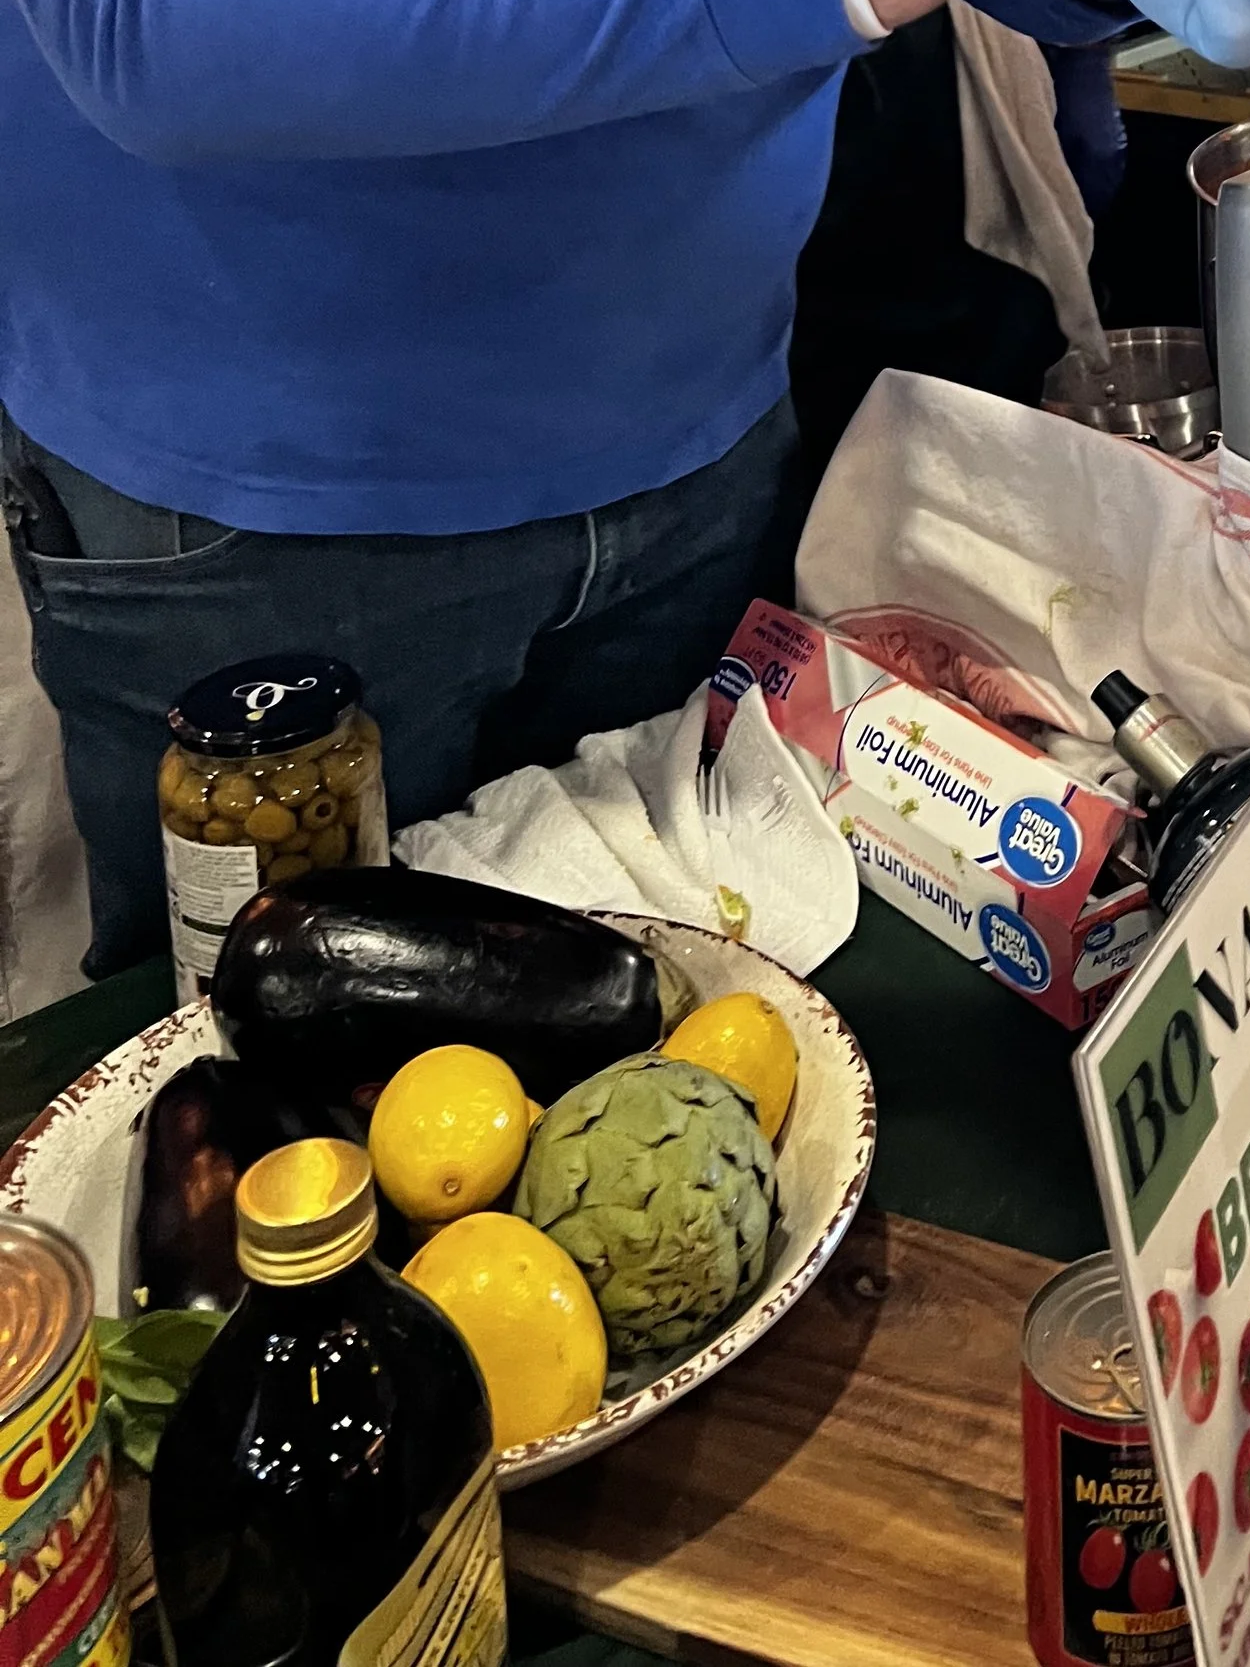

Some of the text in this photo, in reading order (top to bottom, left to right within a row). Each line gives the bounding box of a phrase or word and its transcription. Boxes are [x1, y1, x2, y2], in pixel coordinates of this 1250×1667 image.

[761, 660, 797, 701] 150
[921, 736, 940, 757] Easy
[939, 749, 954, 765] For
[856, 724, 1000, 828] Aluminum Foil
[954, 758, 974, 778] Pans
[974, 771, 993, 790] Line
[1020, 808, 1062, 840] Value
[1009, 823, 1065, 876] Great
[846, 832, 973, 932] Aluminum Fo
[990, 913, 1029, 951] Value
[990, 928, 1043, 982] Great
[1075, 1474, 1165, 1505] MARZA
[1113, 1508, 1166, 1523] TOMAT
